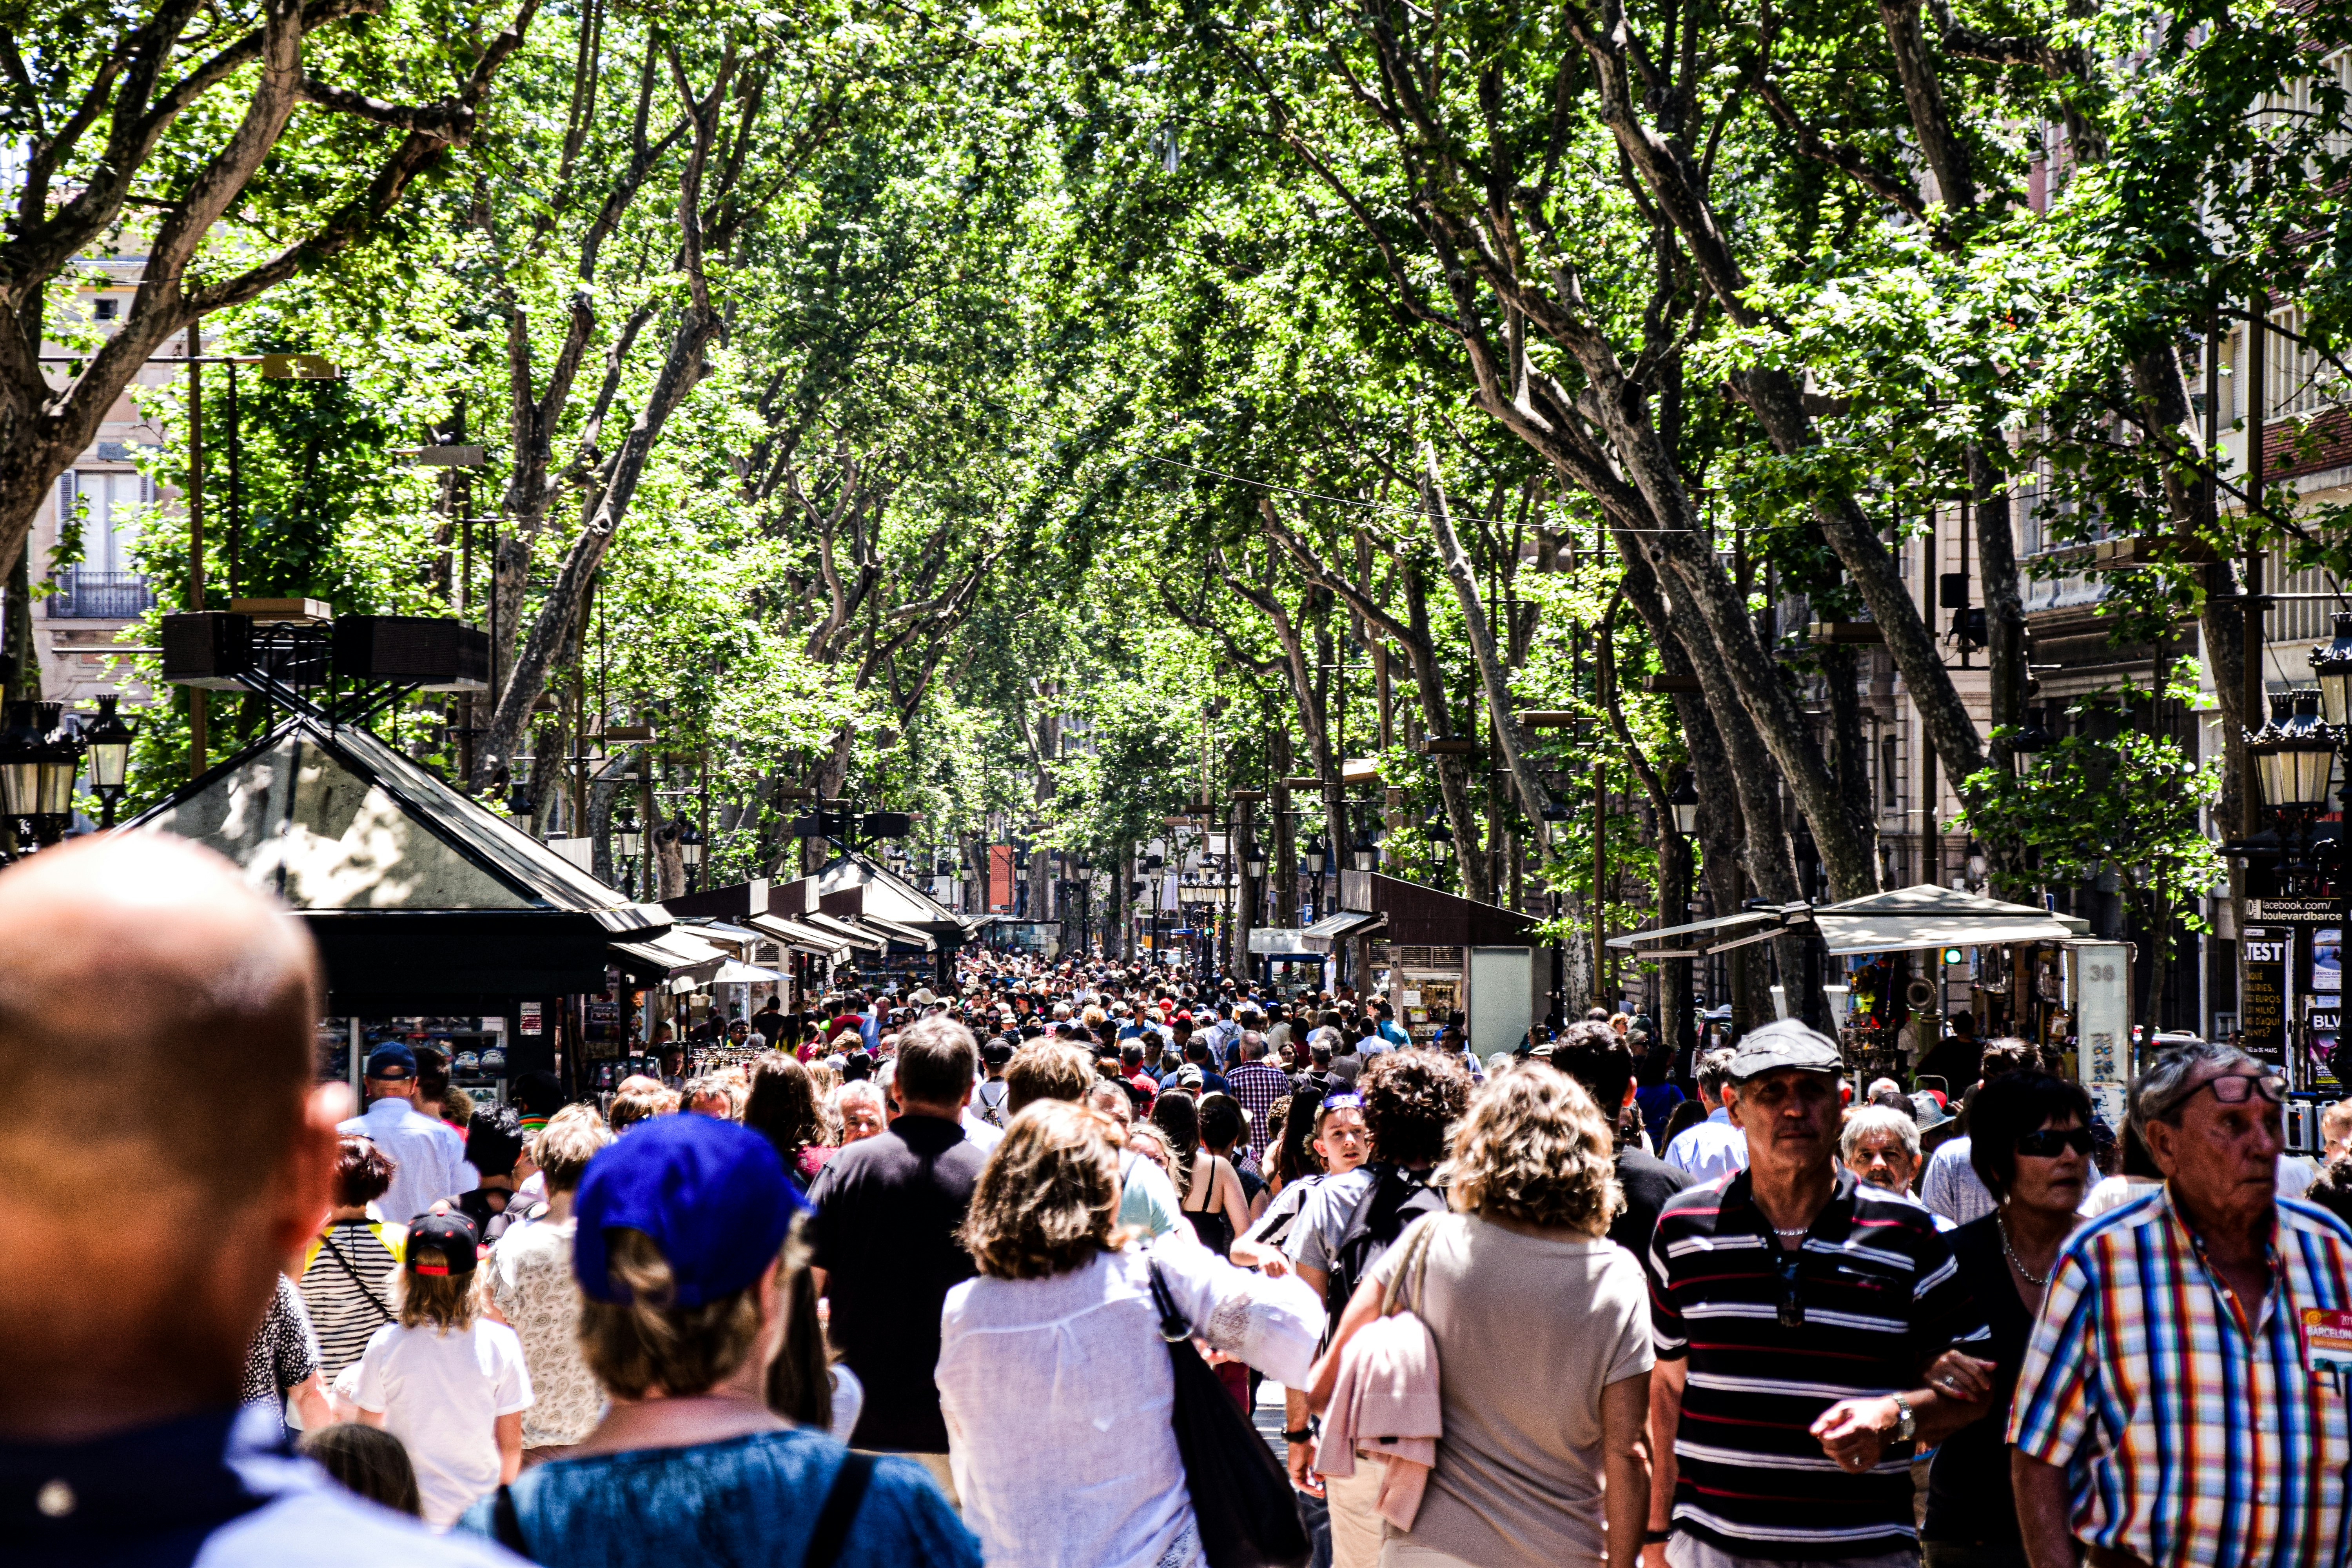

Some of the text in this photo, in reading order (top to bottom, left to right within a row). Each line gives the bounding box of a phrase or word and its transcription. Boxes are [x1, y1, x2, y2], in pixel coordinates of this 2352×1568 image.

[2263, 900, 2332, 909] facebook.com/
[1306, 906, 1312, 920] P
[2256, 1014, 2280, 1025] D'AQUÍ
[2314, 1015, 2340, 1027] BLV
